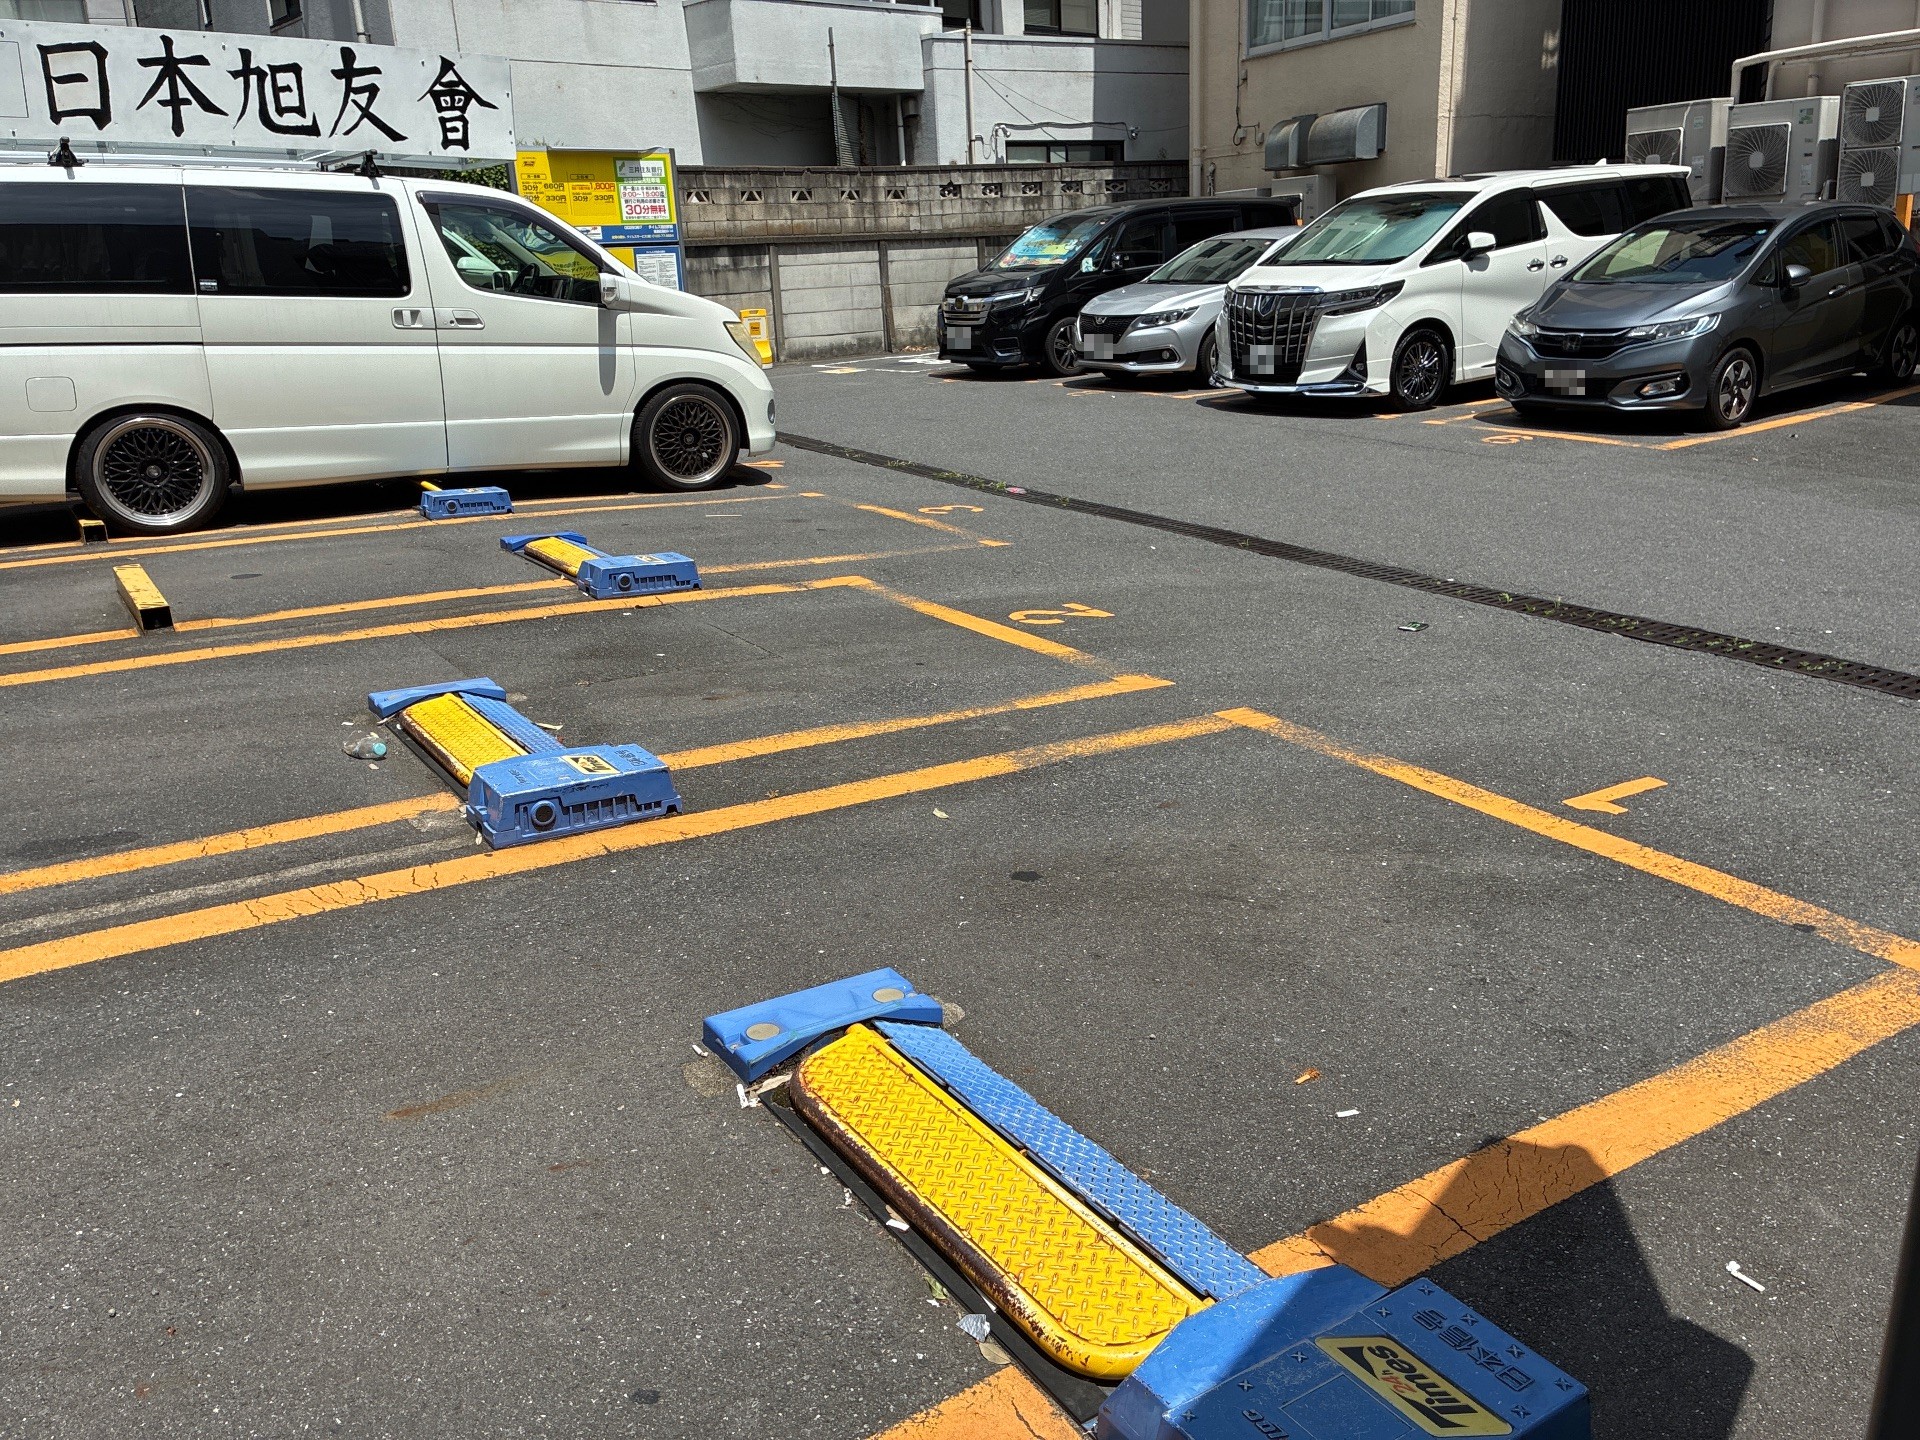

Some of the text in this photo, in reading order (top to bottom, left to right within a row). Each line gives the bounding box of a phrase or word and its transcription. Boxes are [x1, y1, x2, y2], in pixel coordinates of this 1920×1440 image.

[37, 34, 498, 150] 日本旭友會
[629, 166, 663, 174] 三井住友銀行
[625, 204, 667, 215] 30分無料
[1008, 601, 1116, 625] 2
[1412, 1307, 1536, 1392] 日本信号
[1367, 1343, 1479, 1419] Times
